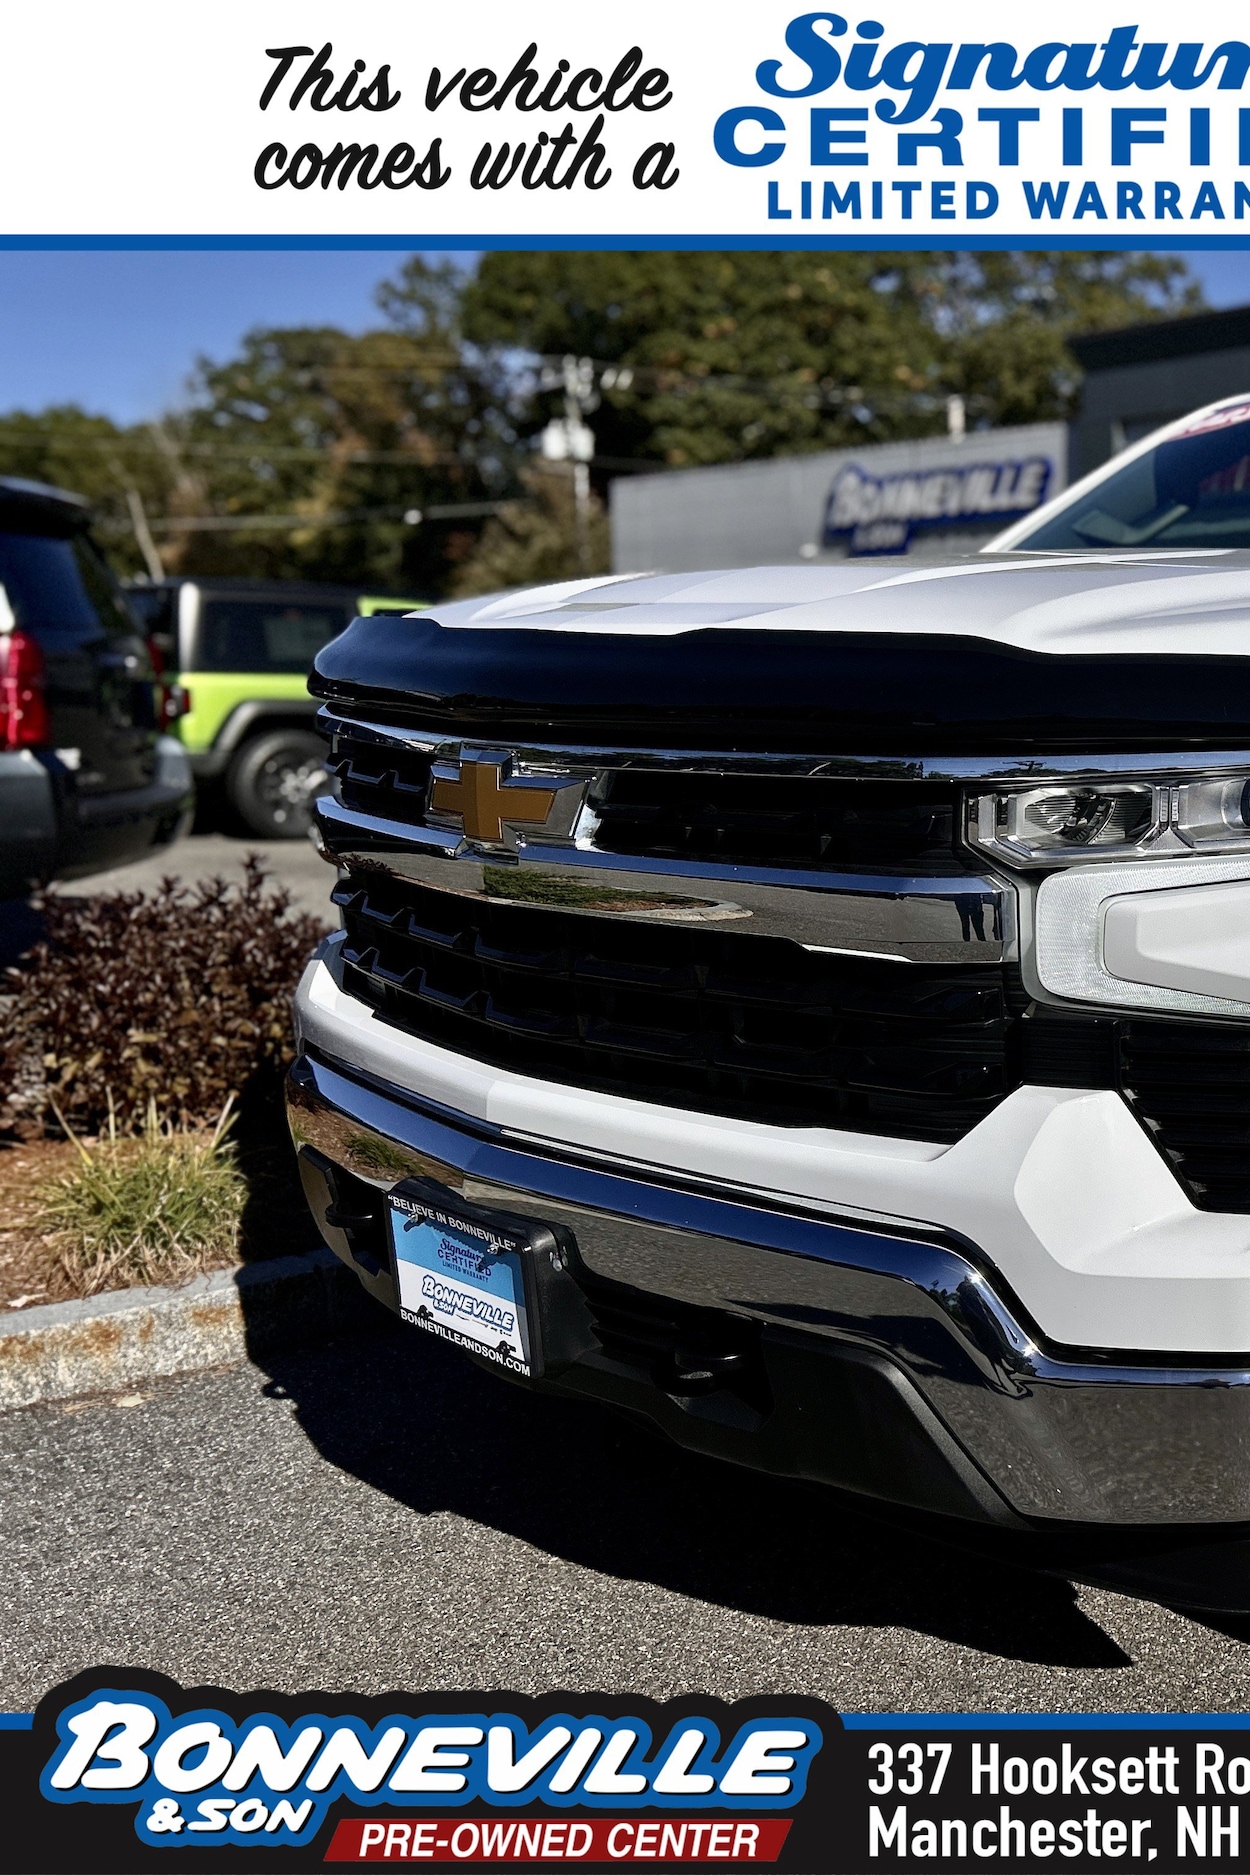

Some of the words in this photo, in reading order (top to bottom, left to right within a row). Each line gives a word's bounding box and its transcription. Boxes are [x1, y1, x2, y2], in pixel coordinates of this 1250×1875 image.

[435, 1211, 448, 1225] IN
[423, 1275, 514, 1330] BONNEVILLE
[400, 1310, 531, 1377] BONNEVILLEANDSON.COM
